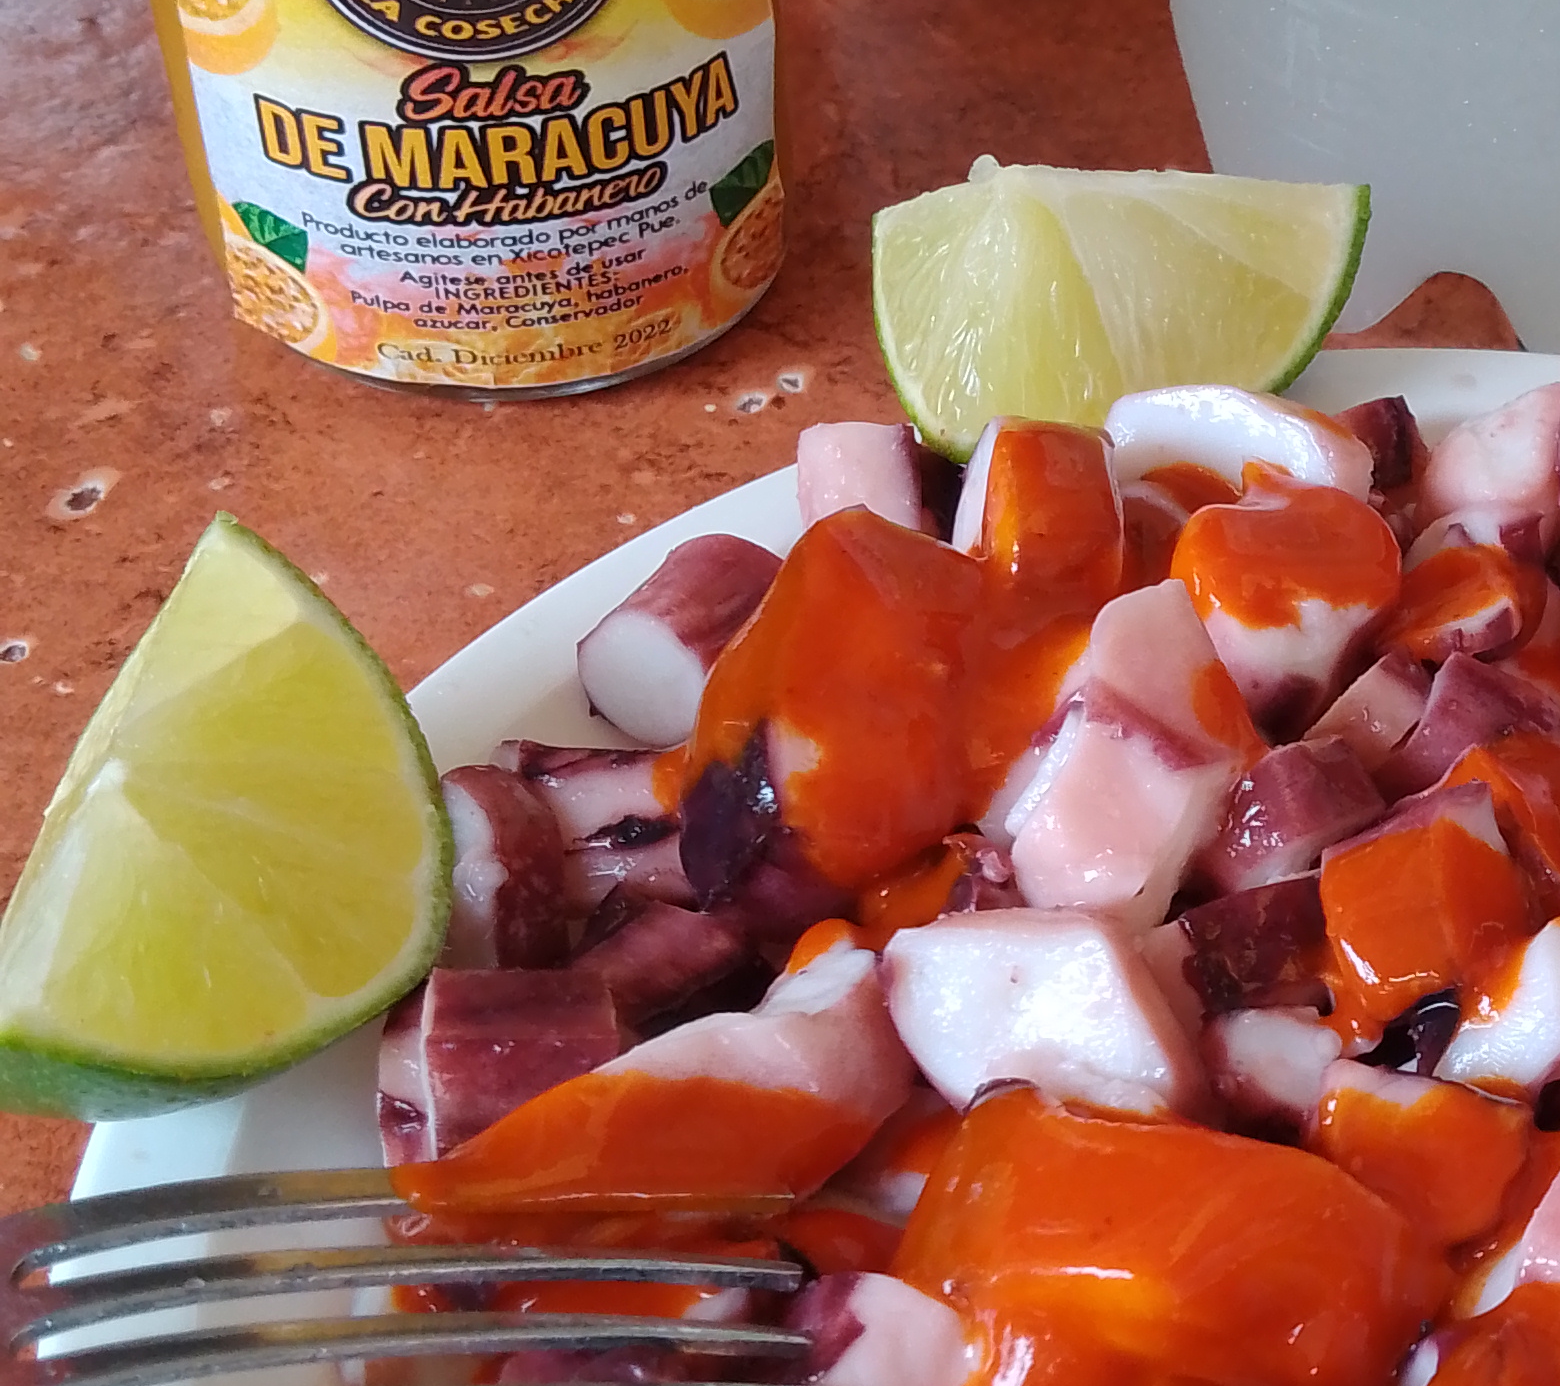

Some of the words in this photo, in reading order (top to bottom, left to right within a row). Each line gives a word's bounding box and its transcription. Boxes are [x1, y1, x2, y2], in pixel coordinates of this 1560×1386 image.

[404, 65, 582, 121] Salsa
[256, 97, 350, 183] DE
[362, 55, 738, 191] MARACUYA
[301, 212, 408, 247] Producto
[416, 228, 551, 249] elaborado
[558, 222, 599, 245] por
[606, 198, 679, 232] manos
[684, 180, 709, 201] de
[350, 183, 452, 225] Con
[452, 166, 662, 225] Habanero
[340, 244, 464, 265] artesanos
[471, 255, 503, 266] en
[509, 229, 631, 265] Xicotepec
[638, 217, 682, 238] Pue.
[434, 270, 622, 302] INGREDIENTES:
[495, 269, 560, 286] antes
[566, 261, 594, 278] de
[600, 247, 647, 270] usar
[351, 290, 411, 313] Pulpa
[419, 300, 448, 314] de
[456, 297, 580, 319] Maracuya,
[505, 294, 645, 330] Conservador
[376, 342, 443, 366] Cad.
[452, 341, 604, 368] Diciembre
[614, 319, 672, 350] 2022
